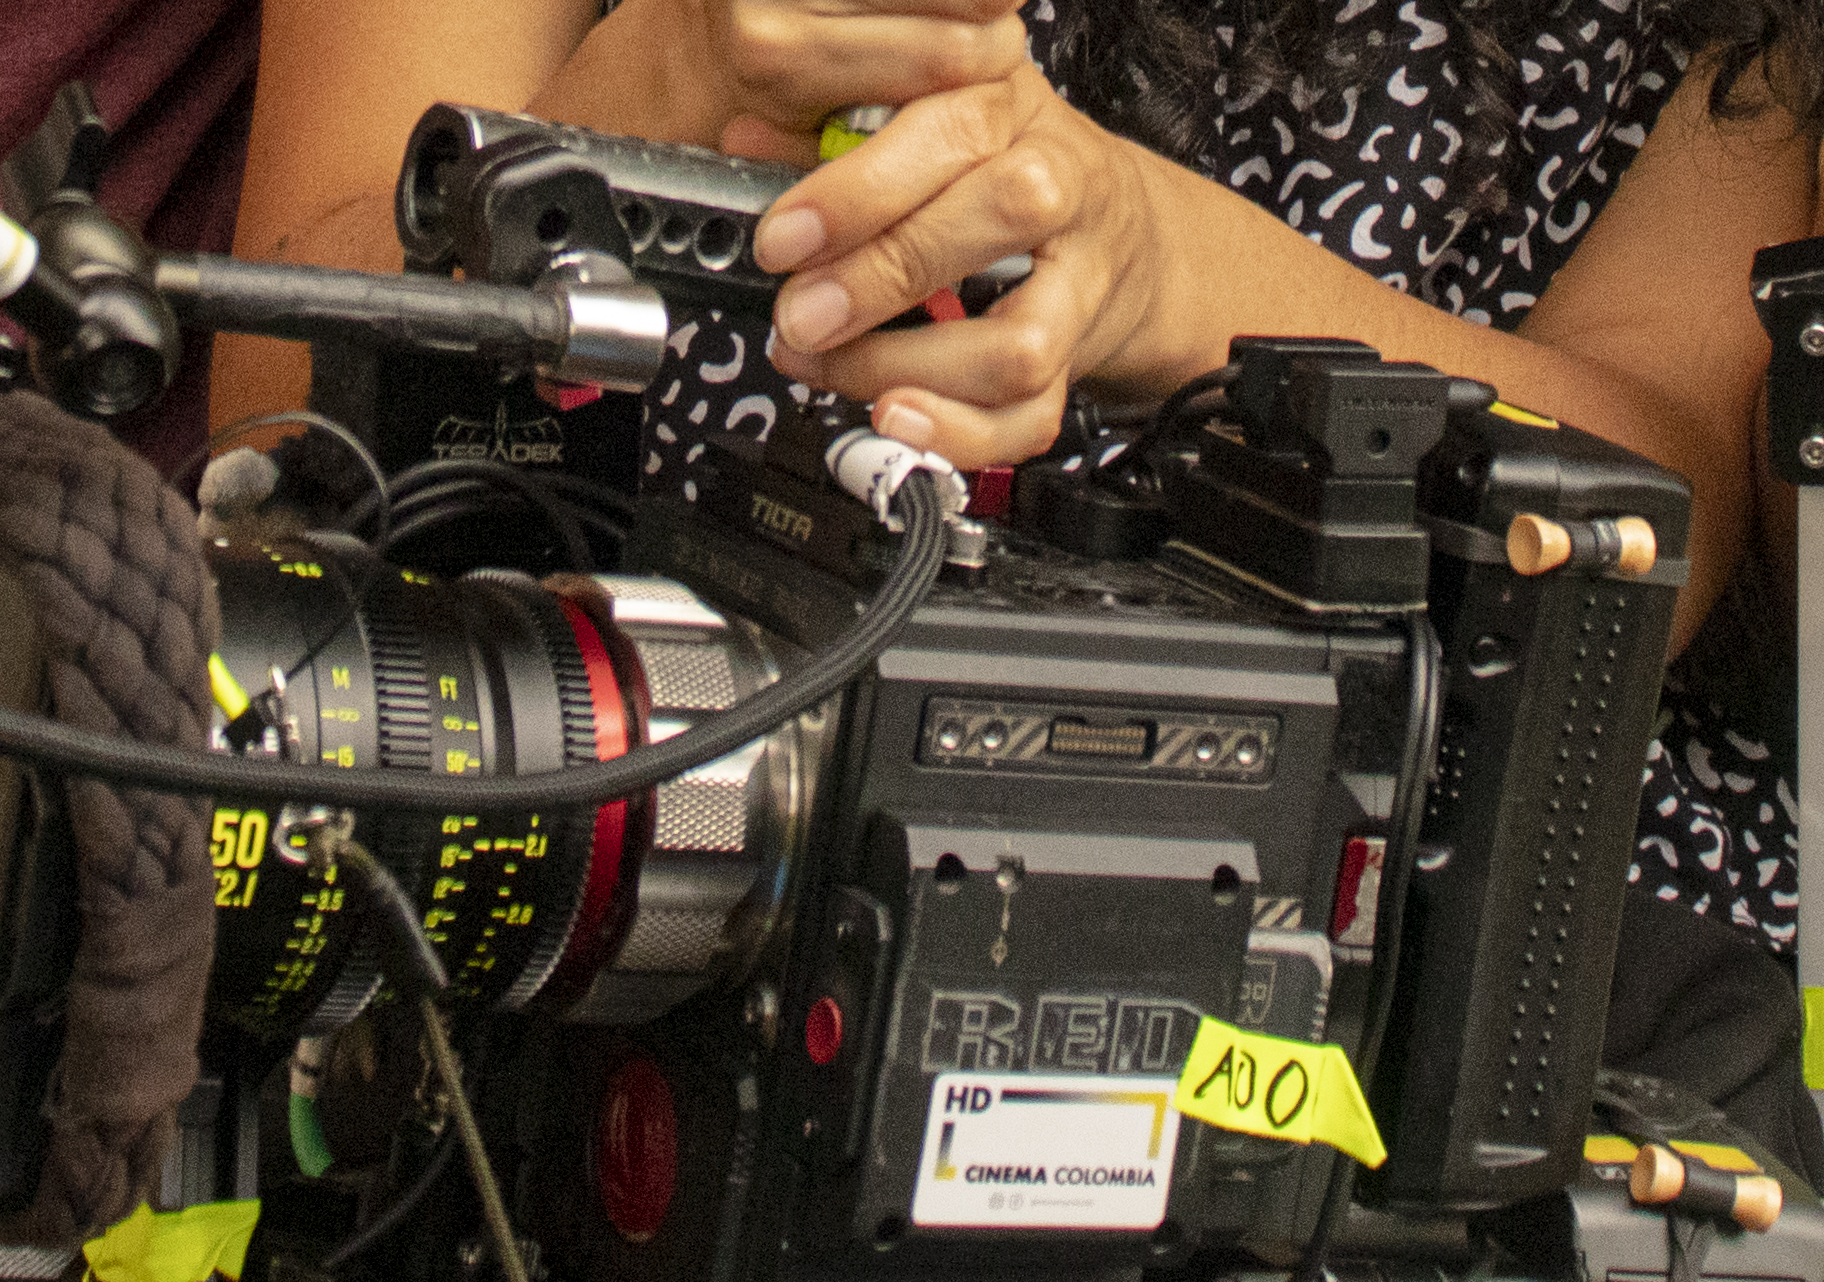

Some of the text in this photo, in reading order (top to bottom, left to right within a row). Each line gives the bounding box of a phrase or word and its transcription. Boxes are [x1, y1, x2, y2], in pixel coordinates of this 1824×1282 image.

[210, 808, 269, 869] 50
[920, 987, 1205, 1074] RED
[943, 1085, 993, 1114] HD
[964, 1165, 1156, 1187] CINEMA COLOMBIA
